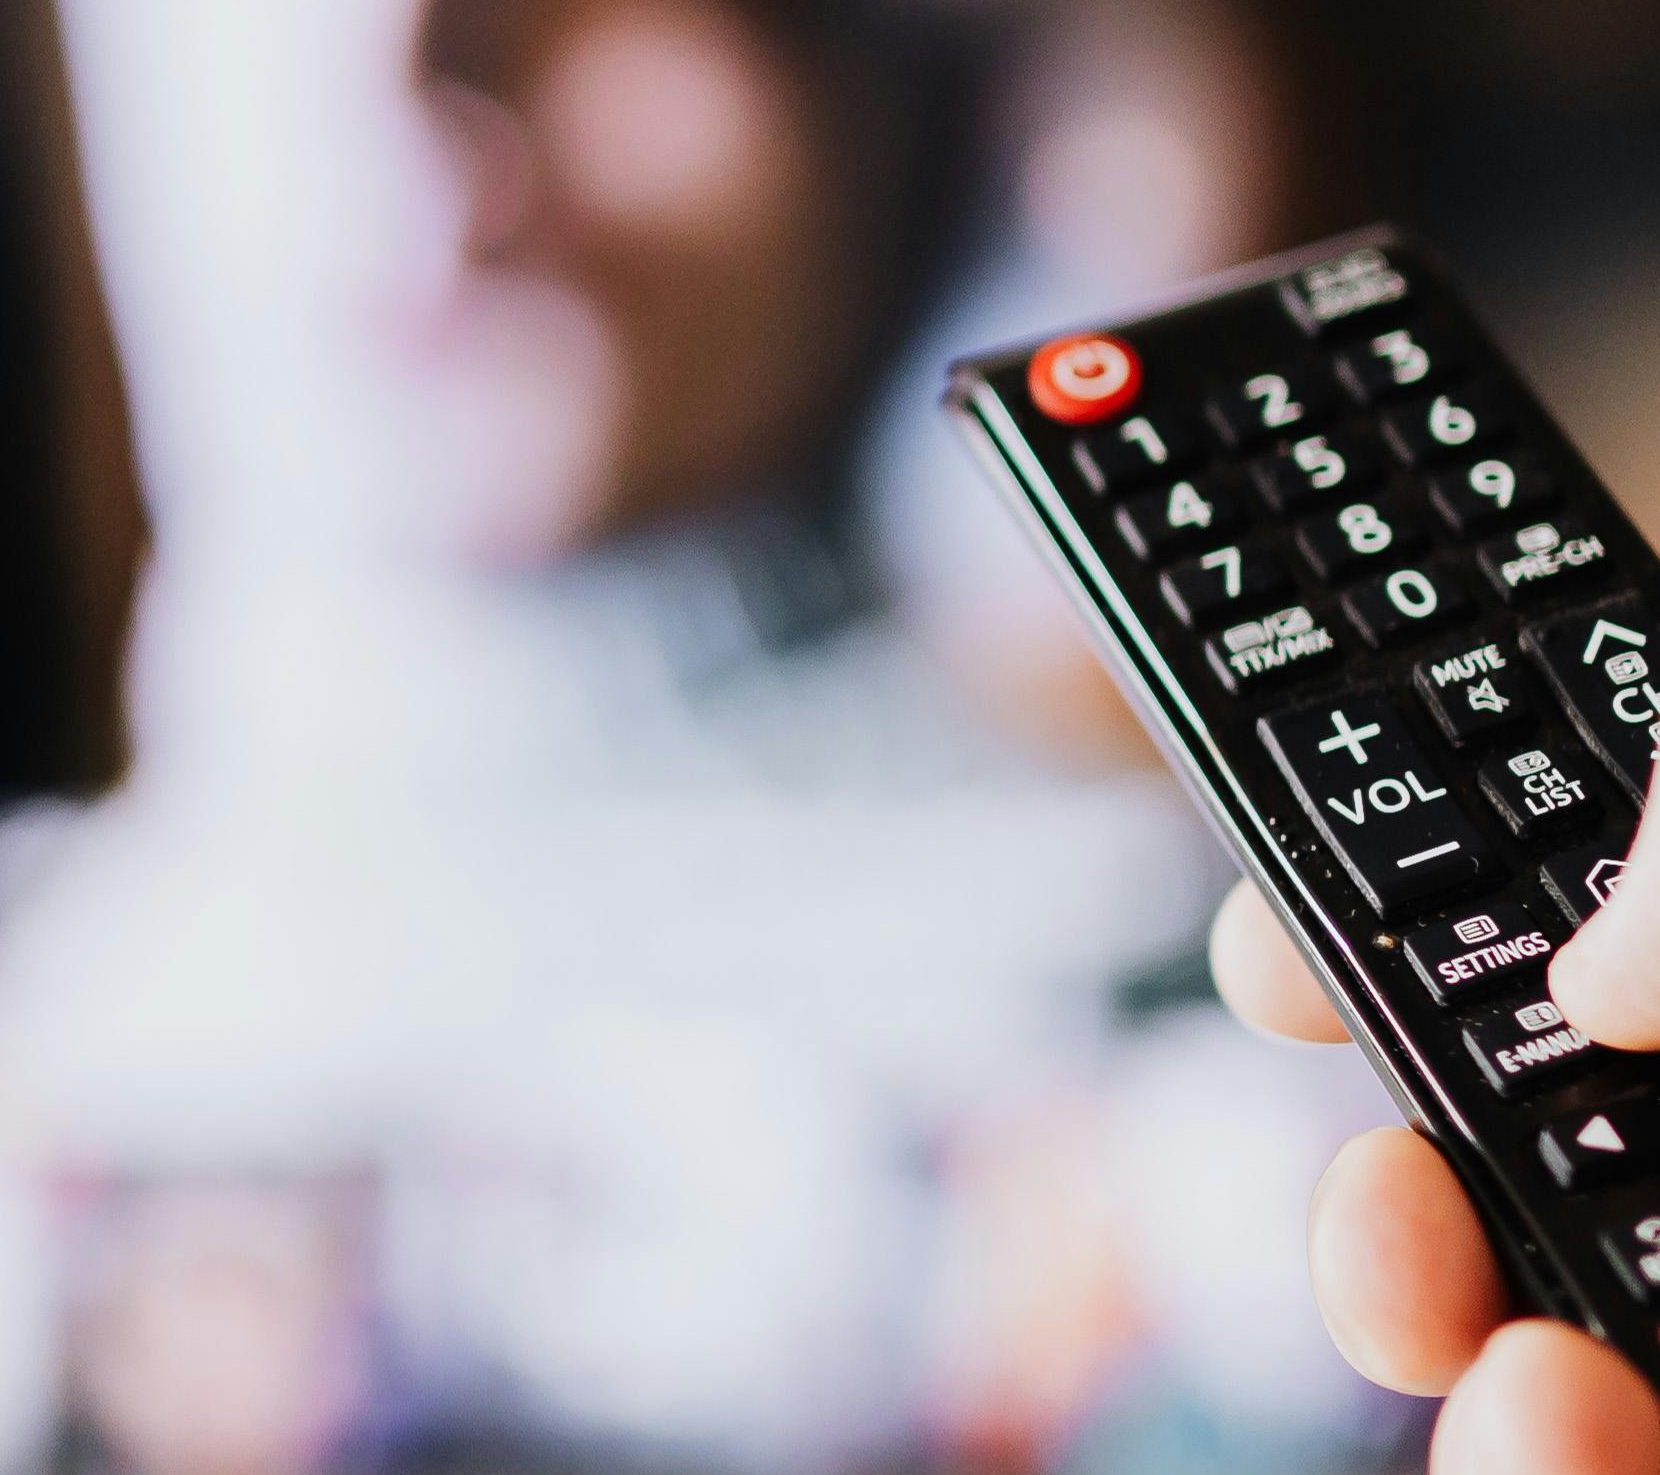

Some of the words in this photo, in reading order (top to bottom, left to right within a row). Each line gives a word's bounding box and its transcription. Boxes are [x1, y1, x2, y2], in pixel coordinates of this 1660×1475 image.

[1372, 330, 1429, 384] 3
[1245, 375, 1304, 427] 2
[1428, 395, 1476, 445] 6
[1121, 417, 1168, 464] 1
[1292, 435, 1346, 488] 5
[1167, 481, 1213, 528] 4
[1469, 460, 1515, 509] 9
[1338, 504, 1392, 554] 8
[1201, 547, 1241, 598] 7
[1386, 570, 1438, 618] 0
[1432, 644, 1507, 687] MUTE
[1327, 770, 1447, 825] VOL
[1523, 767, 1566, 793] CH
[1524, 780, 1585, 816] LIST
[1437, 931, 1551, 984] SETTINGS
